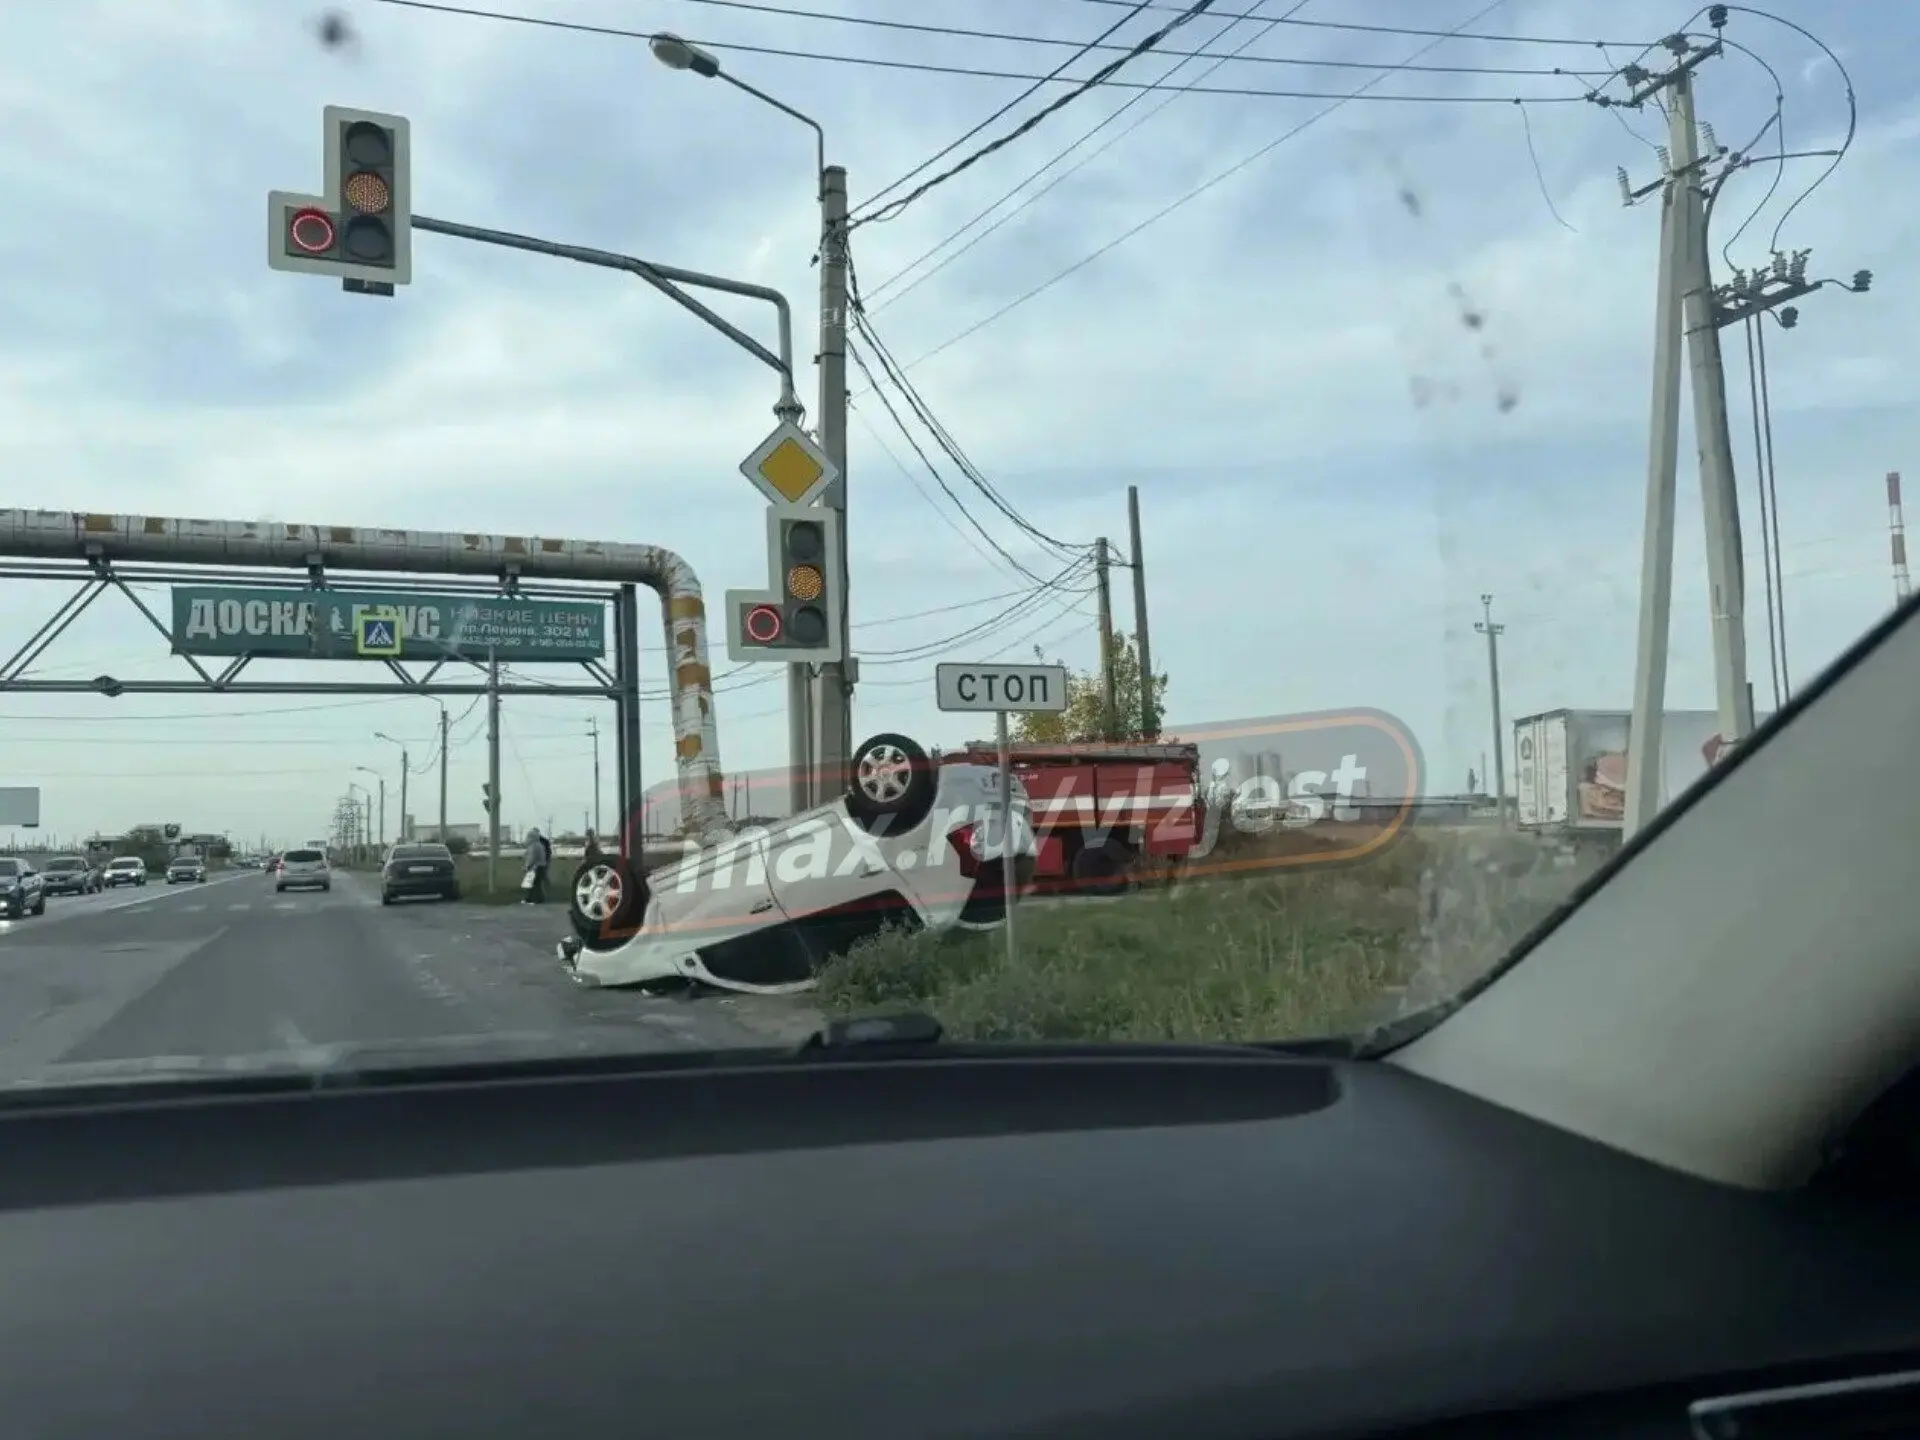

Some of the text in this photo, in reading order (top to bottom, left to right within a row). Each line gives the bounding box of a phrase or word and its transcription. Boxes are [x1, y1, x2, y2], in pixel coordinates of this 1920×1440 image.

[539, 609, 599, 626] ЦЕНЫ
[542, 625, 573, 639] 302
[957, 673, 1048, 702] СТОП
